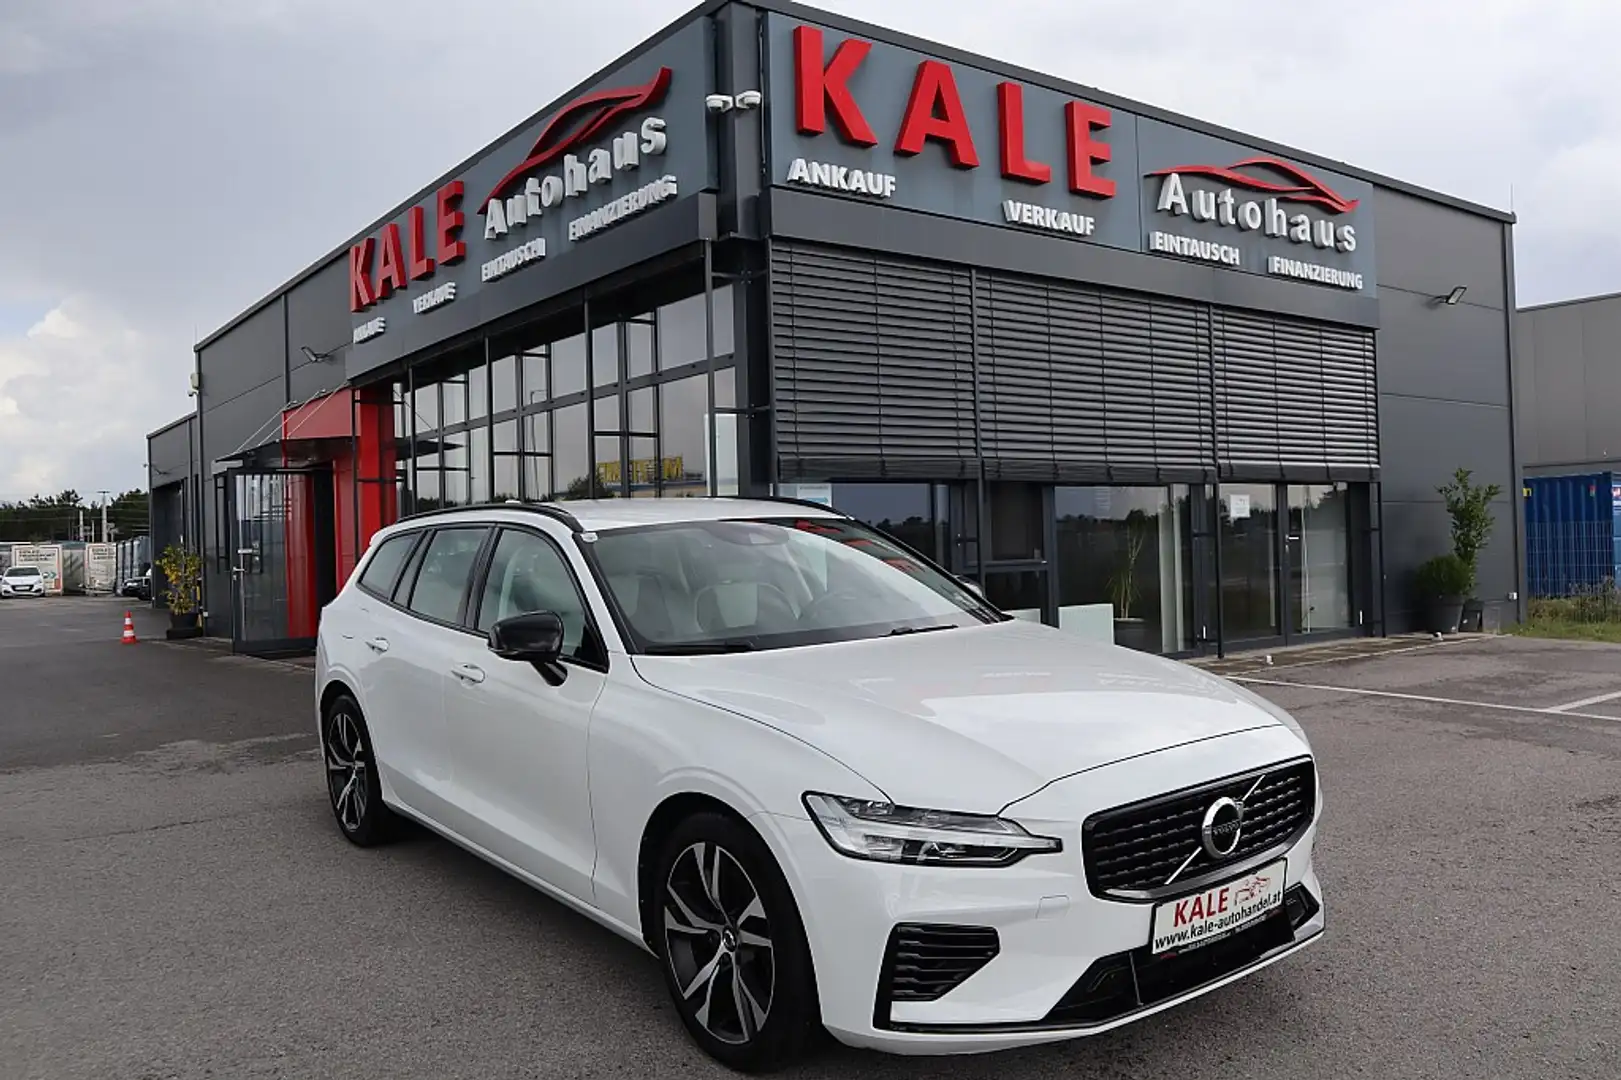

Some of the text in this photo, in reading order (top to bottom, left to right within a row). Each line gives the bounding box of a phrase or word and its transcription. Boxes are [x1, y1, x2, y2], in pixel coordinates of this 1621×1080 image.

[793, 25, 1357, 252] KALE Autohaus
[350, 117, 667, 312] KALE Autohaus
[568, 174, 677, 241] FINANZIERUNG
[787, 158, 1363, 290] ANKAUF VERKAUF EINTAUSCH FINANZIERUNG
[1155, 890, 1281, 949] www.kale-autohandel.at
[1174, 888, 1229, 927] KALE
